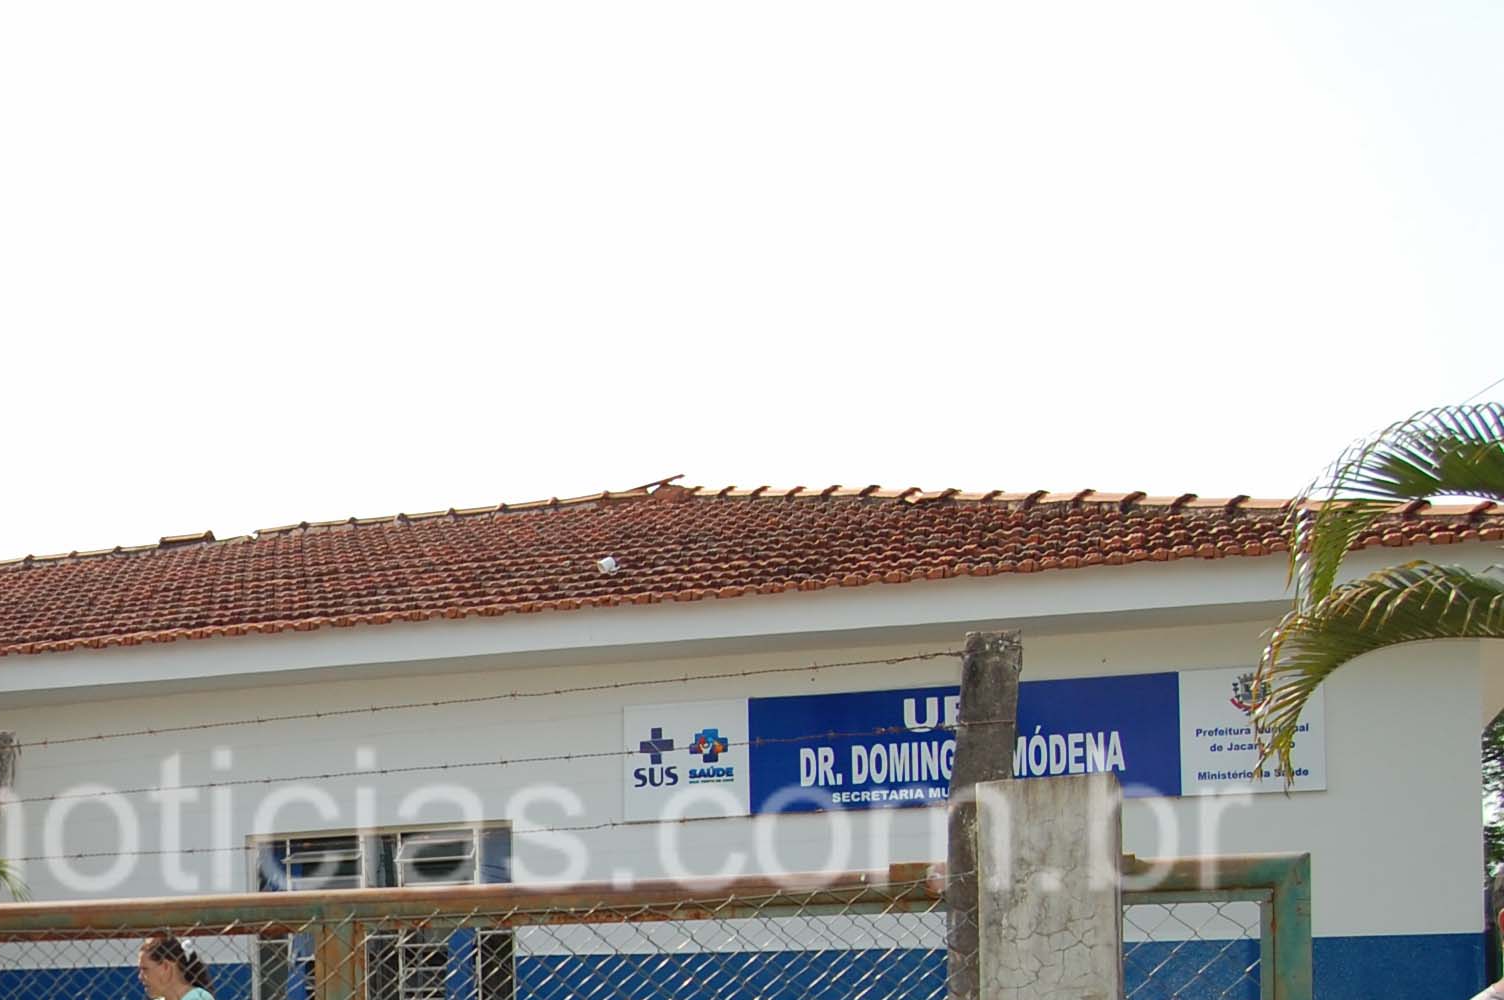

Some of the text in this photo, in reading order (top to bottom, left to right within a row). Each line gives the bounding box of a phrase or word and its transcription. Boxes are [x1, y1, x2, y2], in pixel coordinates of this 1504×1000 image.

[1195, 729, 1251, 737] Prefeitura
[1209, 743, 1223, 752] de
[799, 725, 1126, 787] DR. DOMING MÓDENA
[634, 766, 678, 787] SUS
[688, 766, 734, 779] SAÚDE
[1197, 770, 1254, 781] Ministério
[832, 788, 924, 803] SECRETARIA
